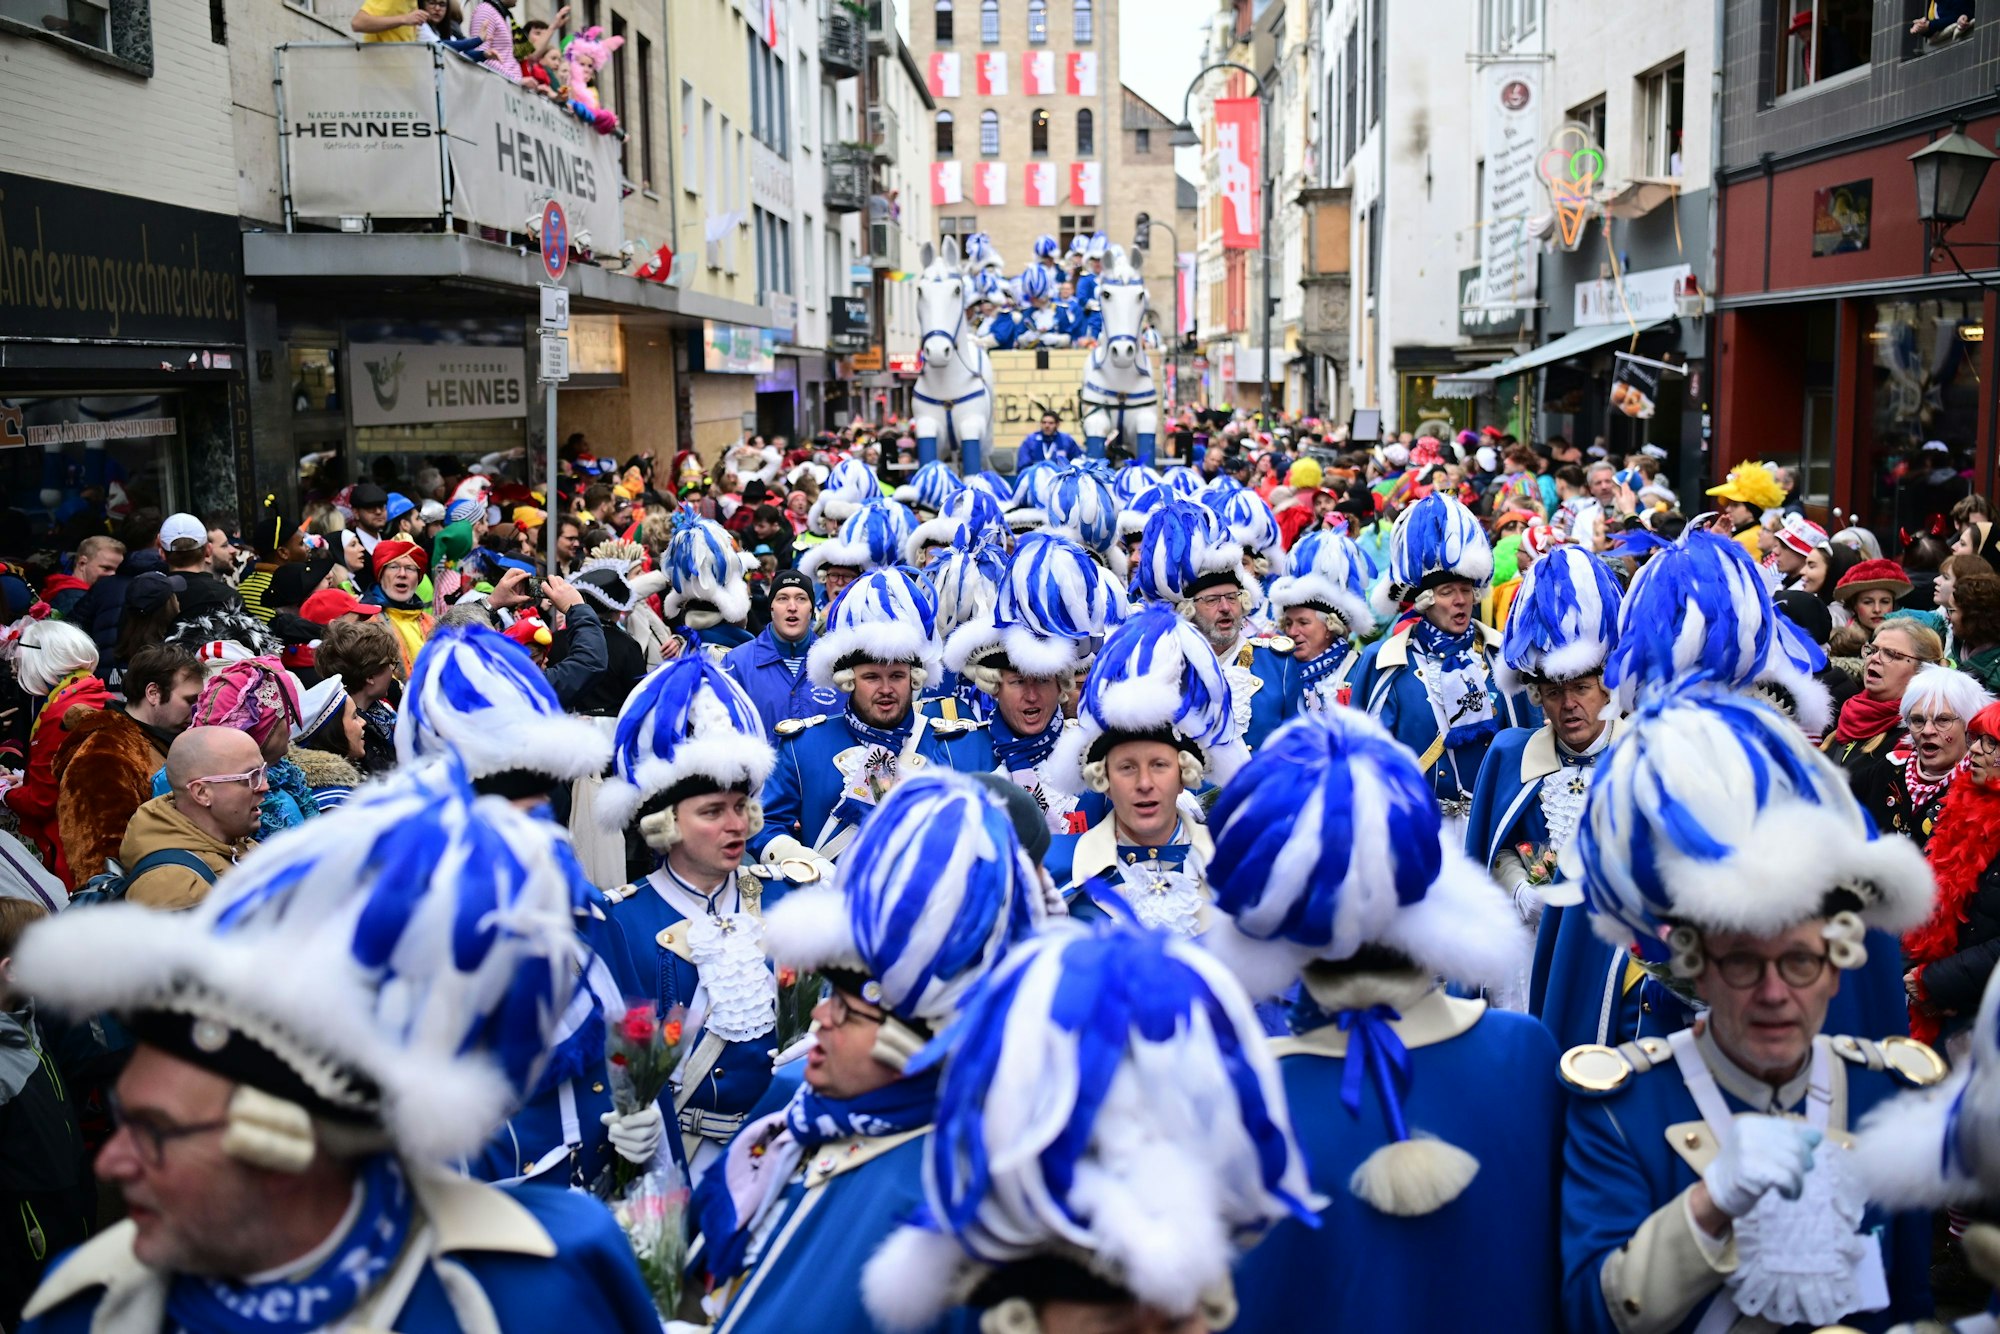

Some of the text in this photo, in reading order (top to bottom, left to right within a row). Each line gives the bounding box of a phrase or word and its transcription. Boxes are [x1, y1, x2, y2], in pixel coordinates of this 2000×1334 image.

[307, 111, 419, 120] NATUR-METZGEREI
[295, 121, 432, 139] HENNES
[495, 121, 597, 204] HENNES
[438, 362, 509, 374] METZGEREI
[426, 378, 521, 408] HENNES
[235, 368, 255, 538] NDERUNG
